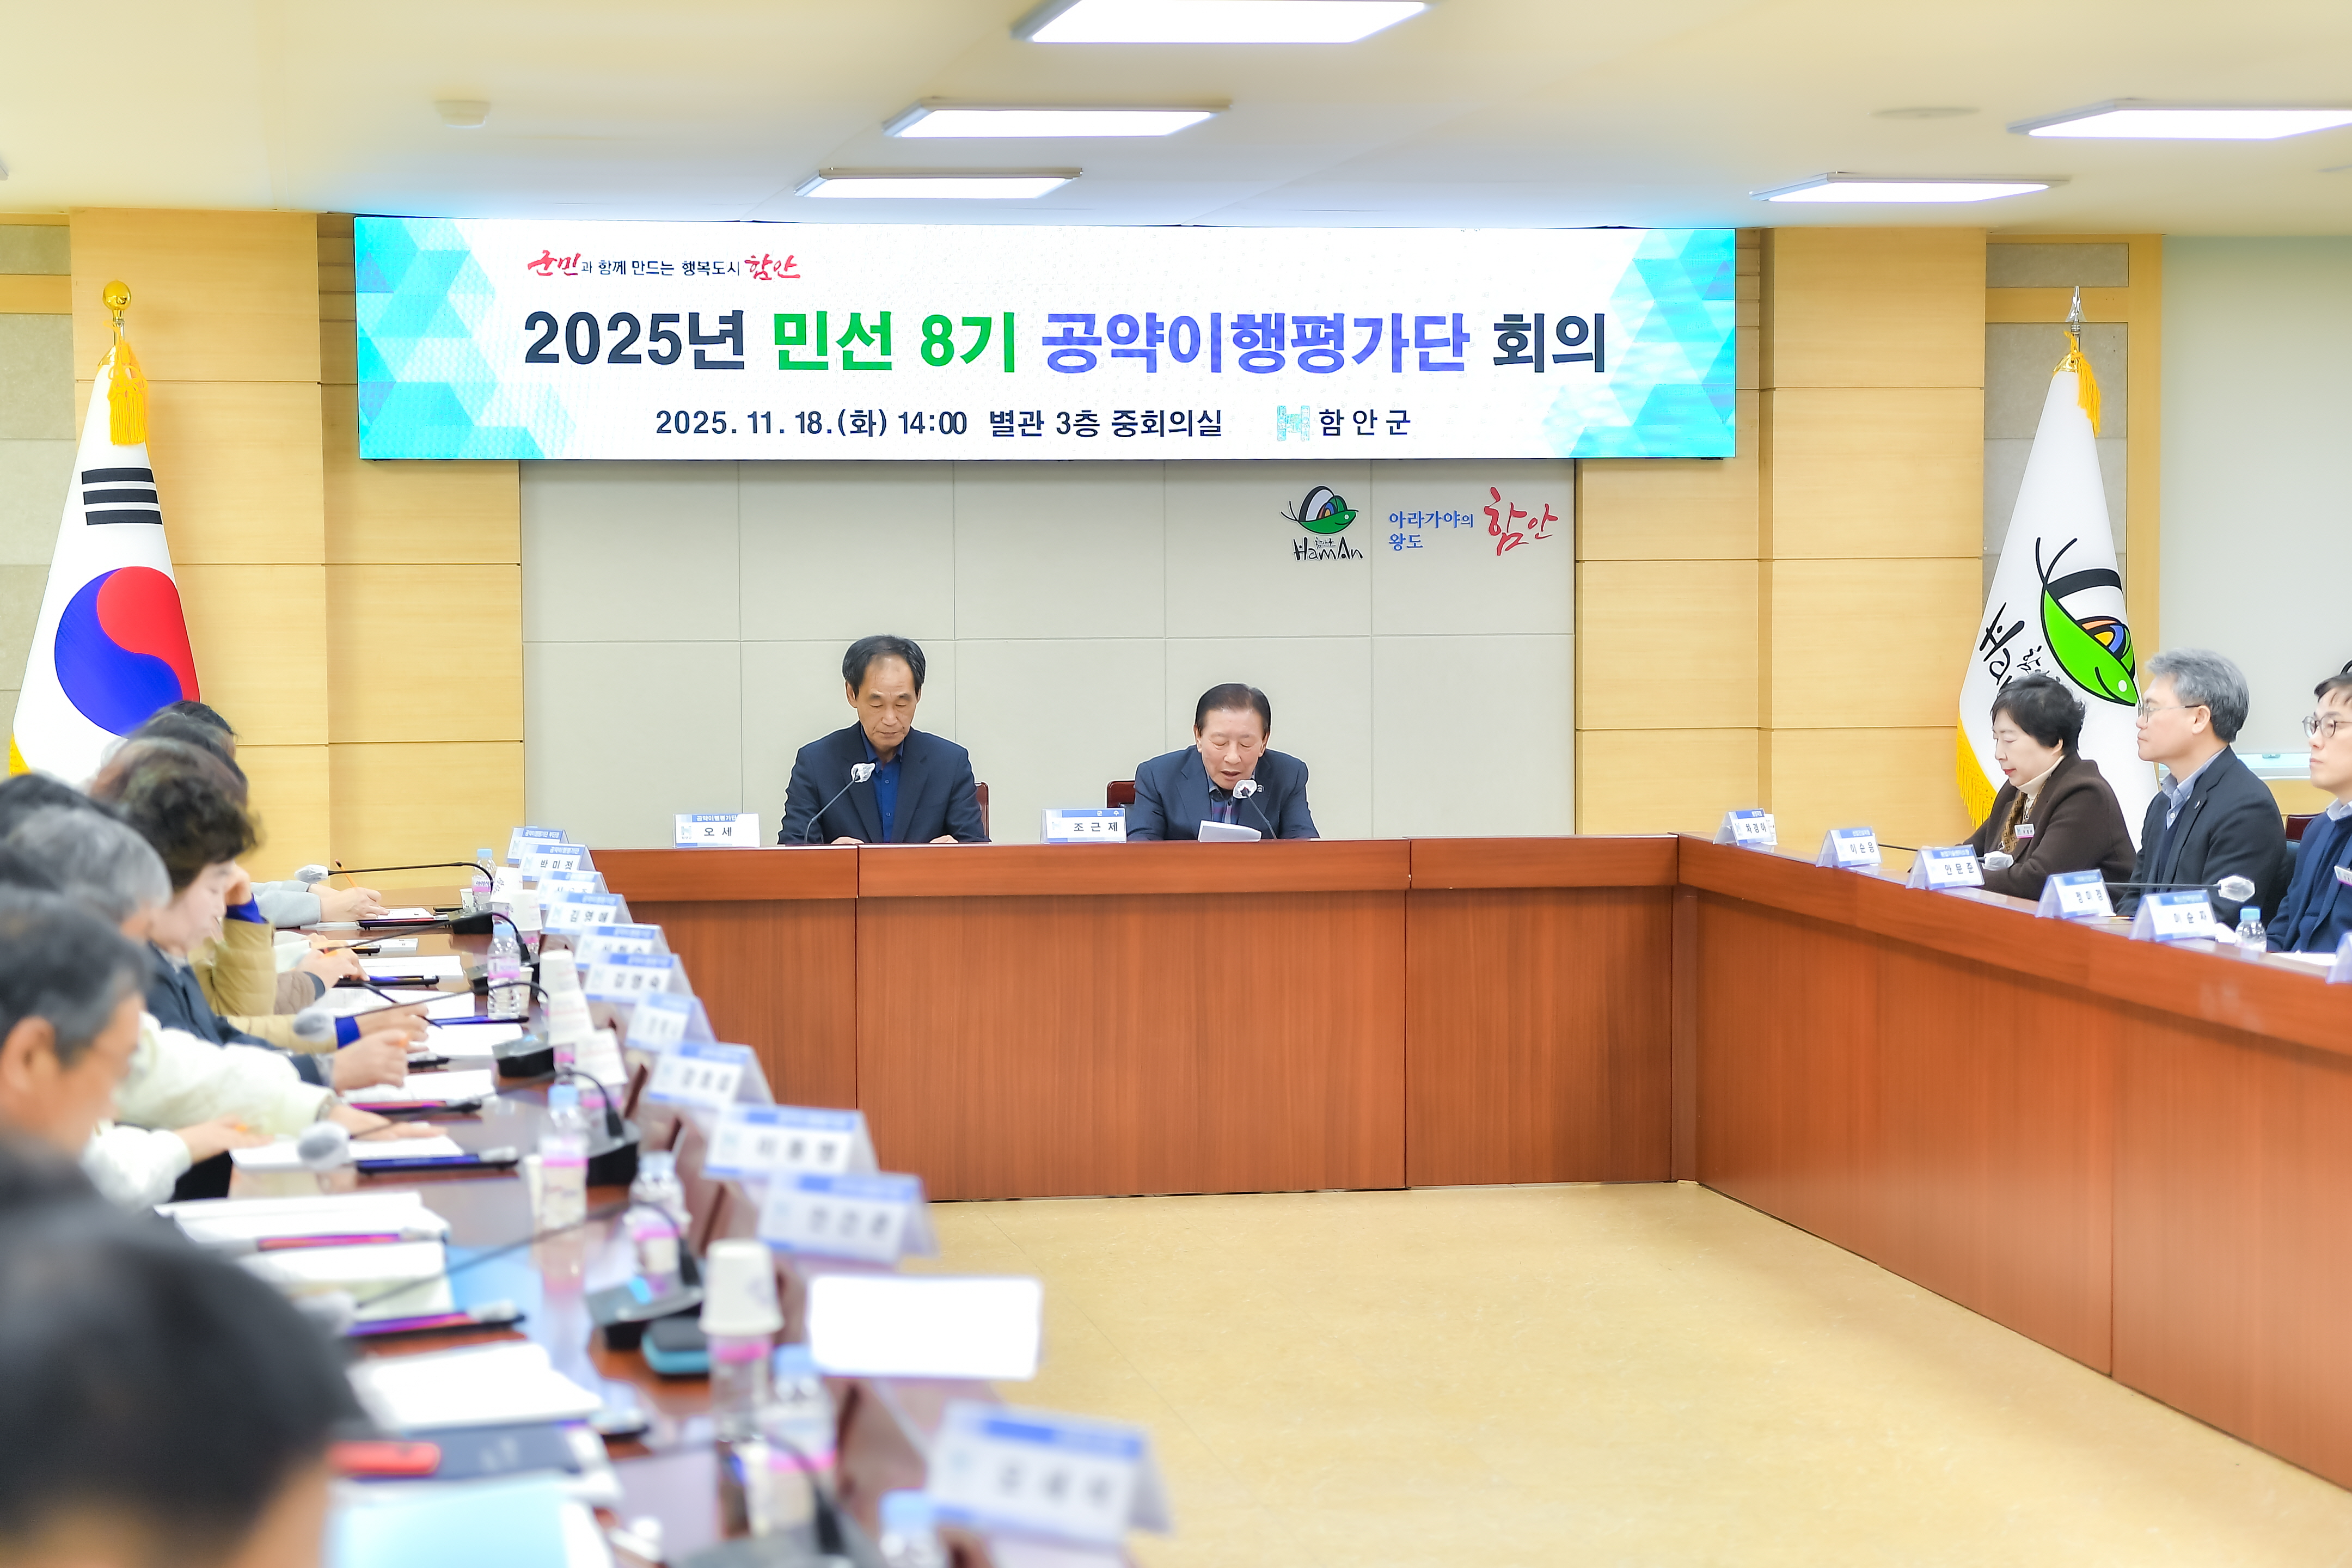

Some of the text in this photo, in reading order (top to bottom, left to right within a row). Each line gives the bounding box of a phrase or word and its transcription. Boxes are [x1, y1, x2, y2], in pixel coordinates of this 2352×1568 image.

[598, 260, 626, 274] 함께
[632, 261, 674, 275] 만드는
[682, 261, 739, 275] 행복도시
[744, 254, 800, 280] 함안
[525, 310, 1604, 373] 2025년 민선 8기 공약이행평가단 회의
[898, 412, 966, 434] 14:00
[990, 410, 1044, 437] 별관
[1057, 410, 1100, 437] 3층
[1112, 410, 1221, 437] 중회의실
[1319, 409, 1411, 436] 함안군
[1389, 511, 1474, 529] 아라가야의
[1484, 487, 1558, 556] 함안
[1389, 533, 1424, 550] 왕도
